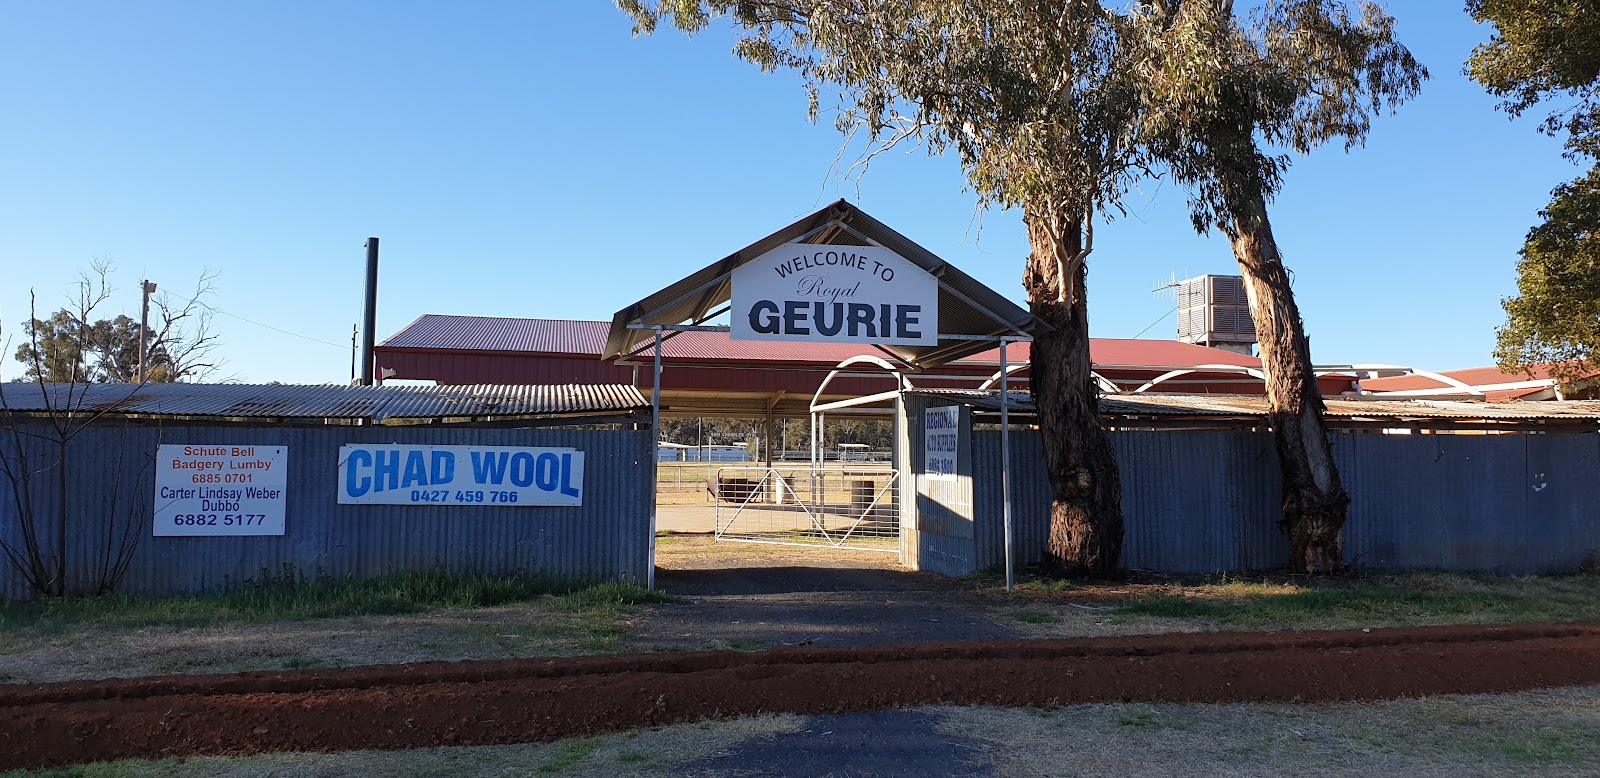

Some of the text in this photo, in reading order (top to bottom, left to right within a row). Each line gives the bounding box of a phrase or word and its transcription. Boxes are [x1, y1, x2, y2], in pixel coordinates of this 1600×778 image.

[774, 251, 895, 282] WELCOME TO
[796, 274, 861, 306] Royal
[748, 299, 922, 339] GEURIE
[926, 411, 957, 429] REGIONAL
[184, 446, 255, 457] Schute Bell
[172, 460, 272, 471] Badgery Lumby
[192, 473, 253, 483] 6885 0701
[346, 449, 580, 498] CHAD WOOL
[160, 486, 281, 502] Carter Lindsay Weber
[411, 490, 518, 503] 0427 459 766
[202, 500, 240, 511] Dubbo
[174, 514, 266, 526] 6882 5177
